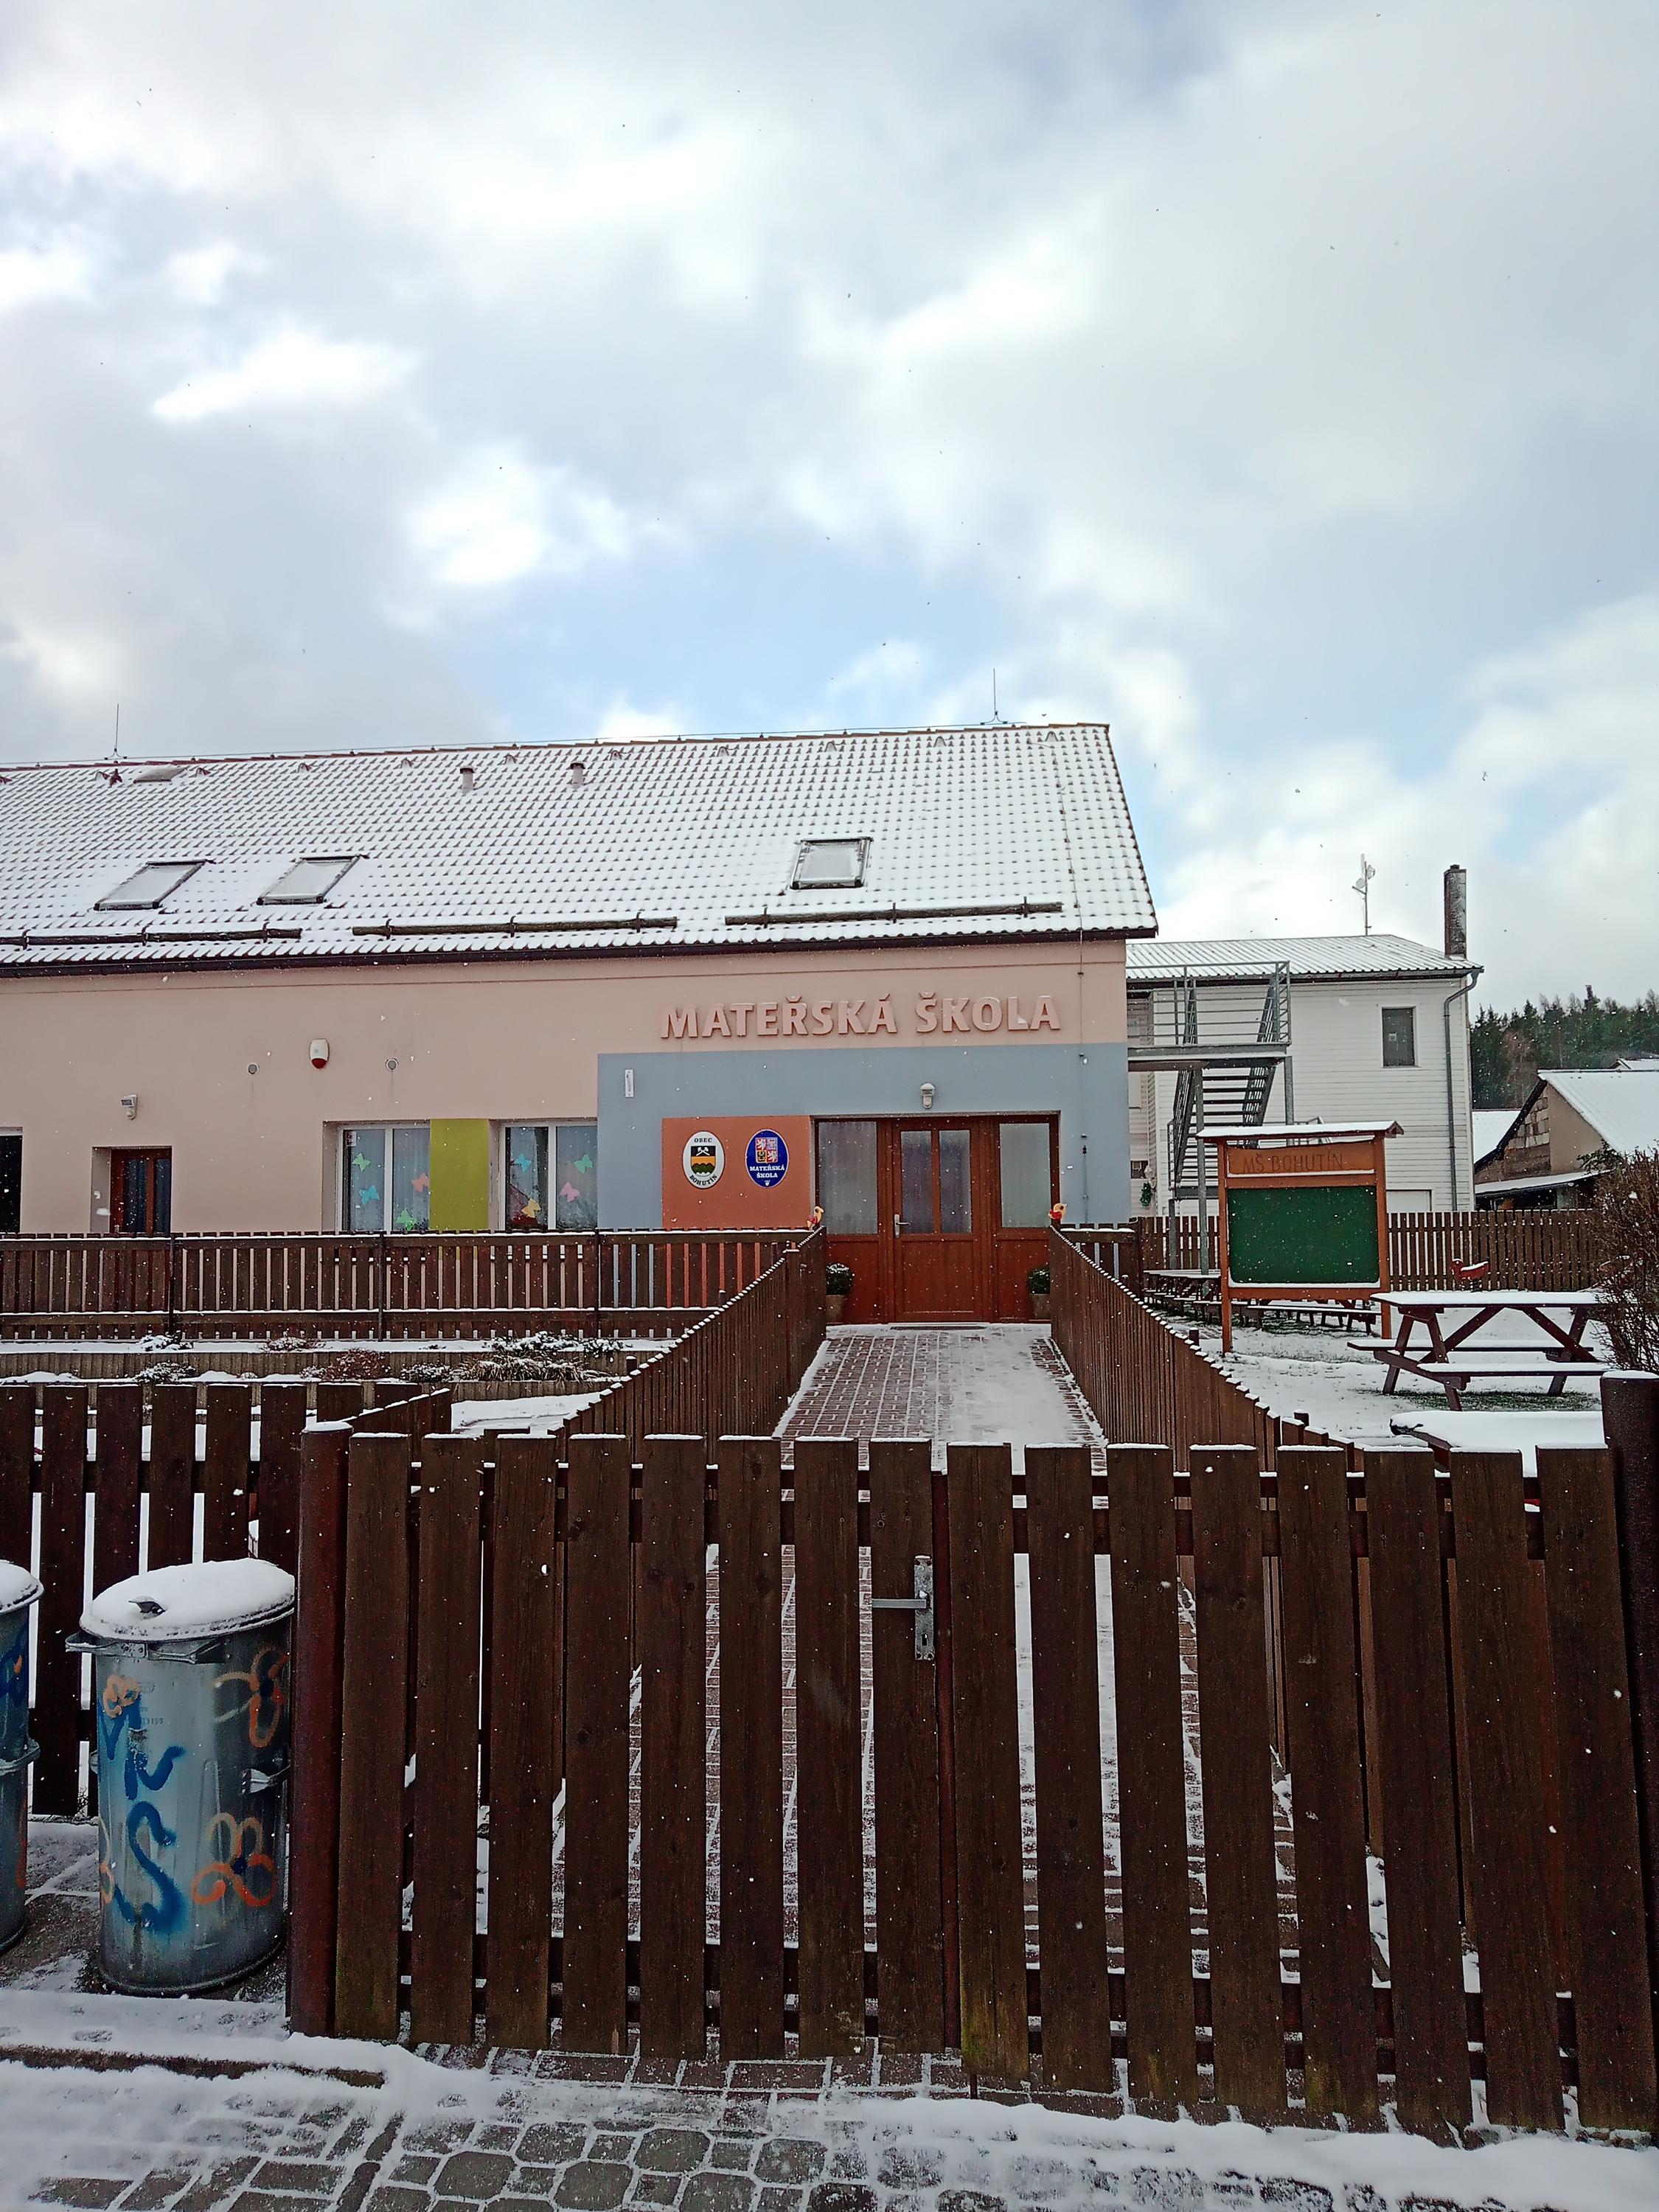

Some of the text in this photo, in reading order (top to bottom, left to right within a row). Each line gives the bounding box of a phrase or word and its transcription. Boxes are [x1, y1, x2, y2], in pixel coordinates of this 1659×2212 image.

[661, 992, 1060, 1038] MATEŘSKÁ ŠKOLA
[1243, 1150, 1343, 1174] MŠ BOHUTÍN
[689, 1174, 717, 1186] BOHUTÍN
